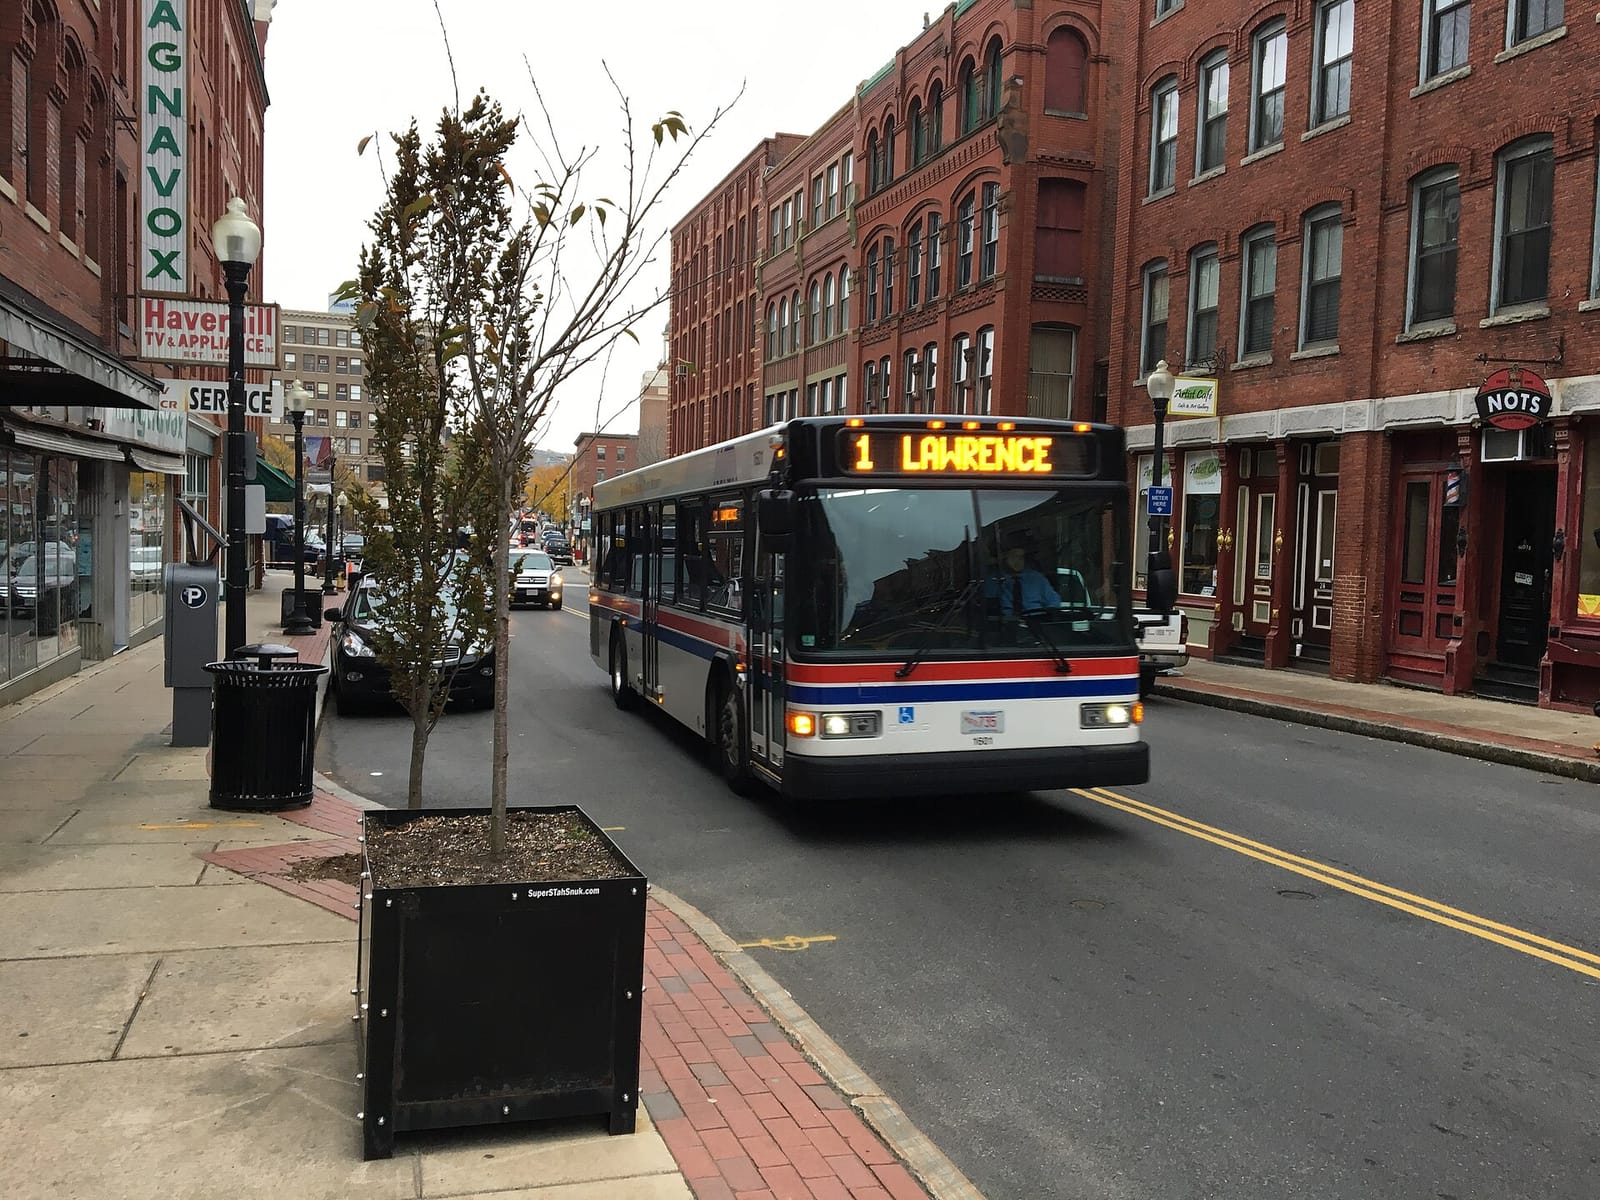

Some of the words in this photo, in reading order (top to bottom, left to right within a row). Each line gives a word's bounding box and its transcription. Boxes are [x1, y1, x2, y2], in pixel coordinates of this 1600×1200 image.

[144, 298, 272, 336] Haverill
[144, 332, 165, 347] TV
[167, 337, 176, 347] &
[189, 387, 273, 414] SERICE
[1487, 391, 1541, 413] NOTS
[855, 434, 874, 471] 1
[902, 435, 1053, 472] LAWRENCE
